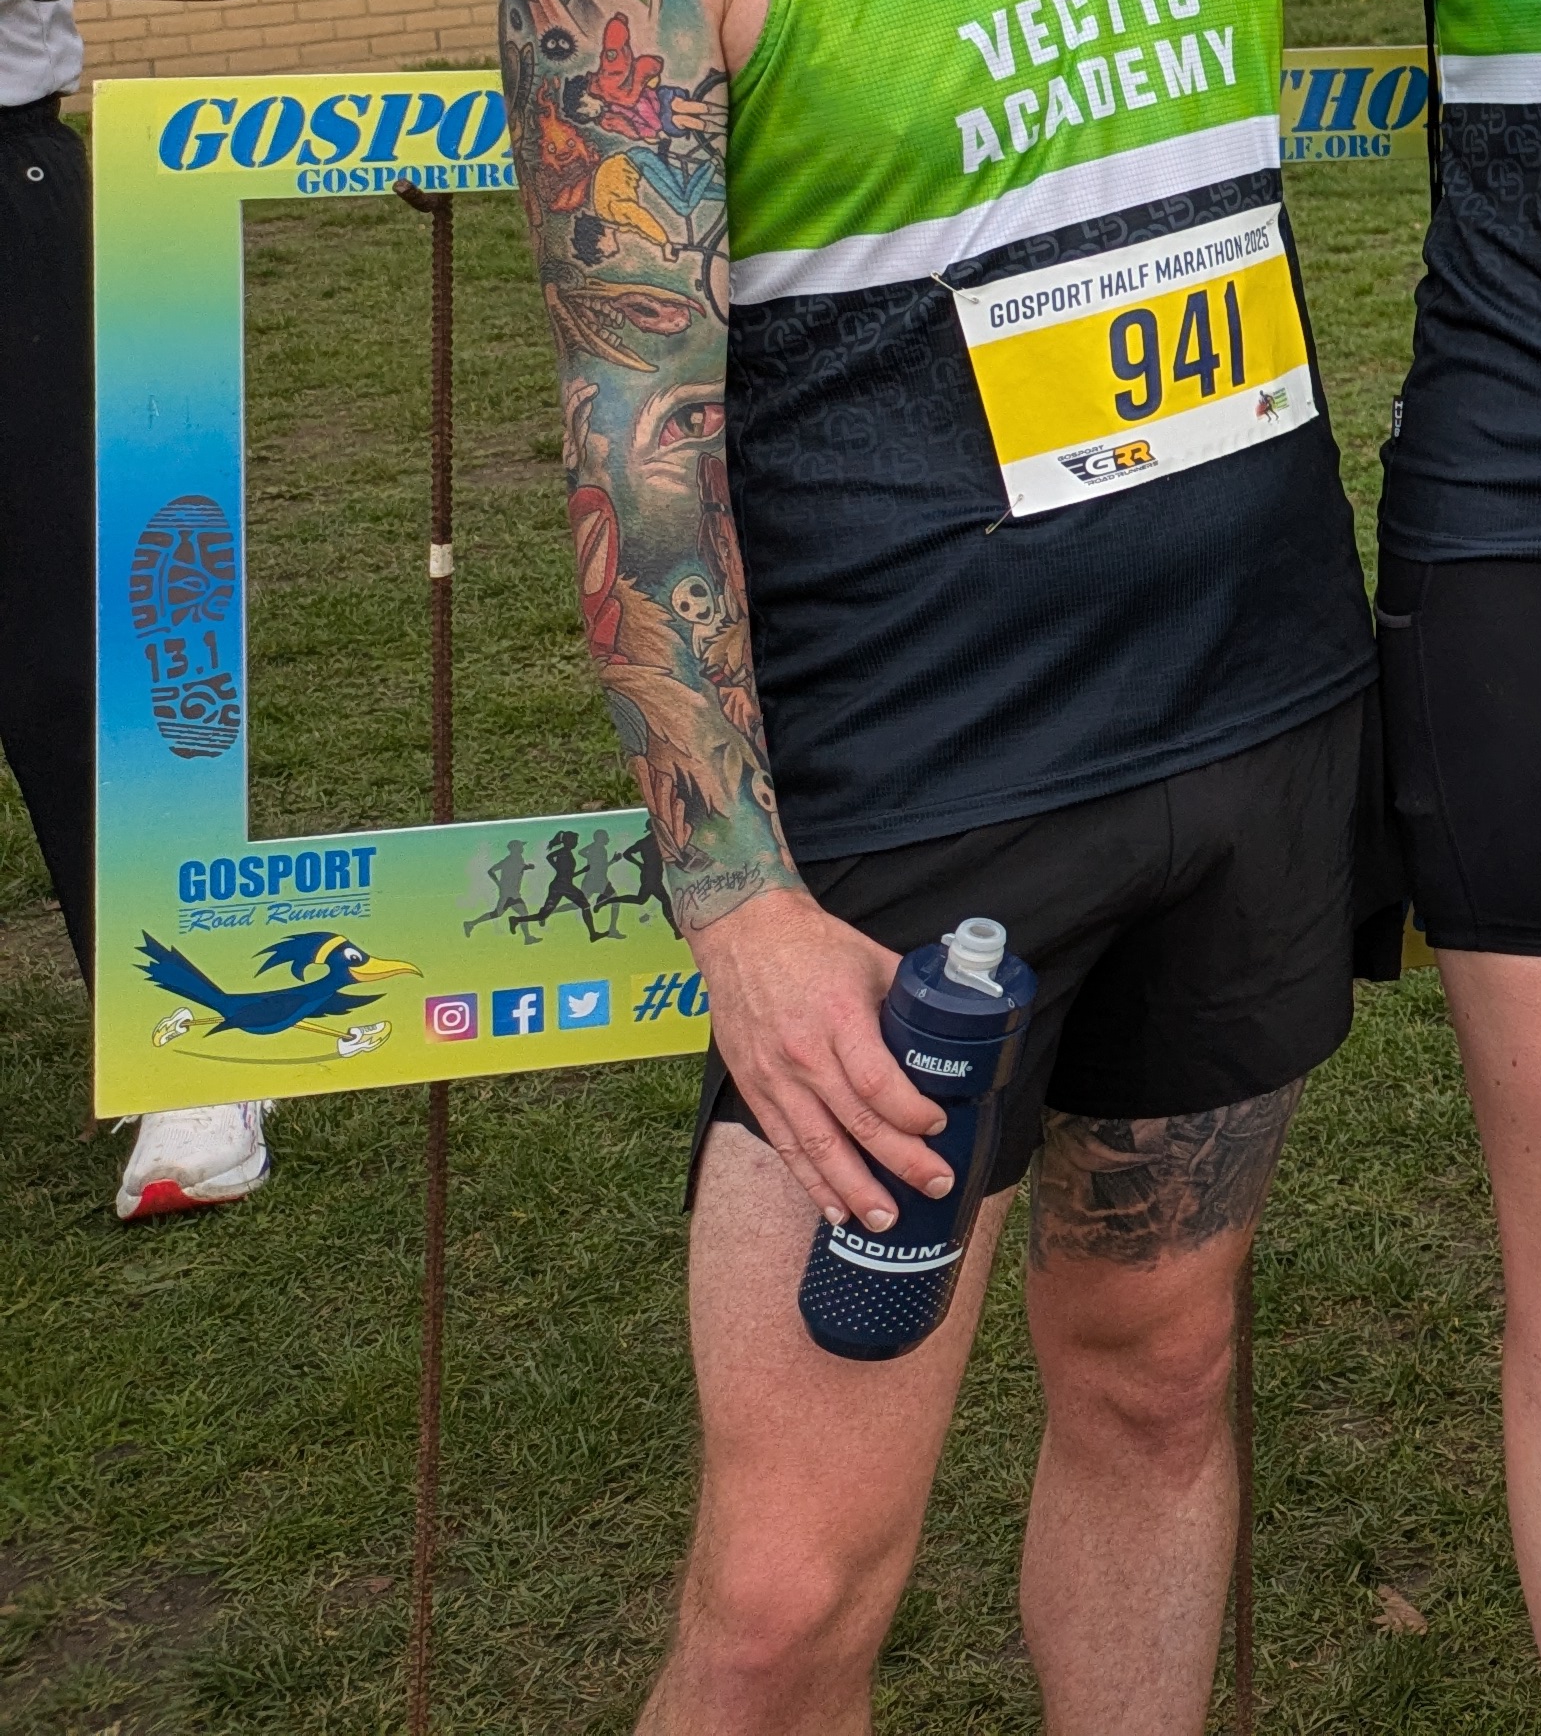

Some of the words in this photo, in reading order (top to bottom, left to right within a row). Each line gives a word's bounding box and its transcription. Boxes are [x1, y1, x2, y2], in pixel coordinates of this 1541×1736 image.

[955, 26, 1236, 174] ACADEMY
[159, 90, 513, 171] GOSPO
[990, 278, 1093, 328] GOSPORT
[1100, 263, 1149, 299] HALF
[1155, 237, 1245, 283] MARATHON
[1244, 226, 1270, 255] 2025
[1109, 280, 1246, 421] 941
[1394, 400, 1404, 438] HUUB
[1057, 445, 1104, 461] GOSPORT
[145, 631, 218, 683] 13.1
[179, 847, 376, 902] GOSPORT
[187, 907, 256, 933] Road
[266, 900, 364, 926] Runners
[906, 1049, 969, 1077] CAMELBAK
[832, 1226, 947, 1260] PODIUM
